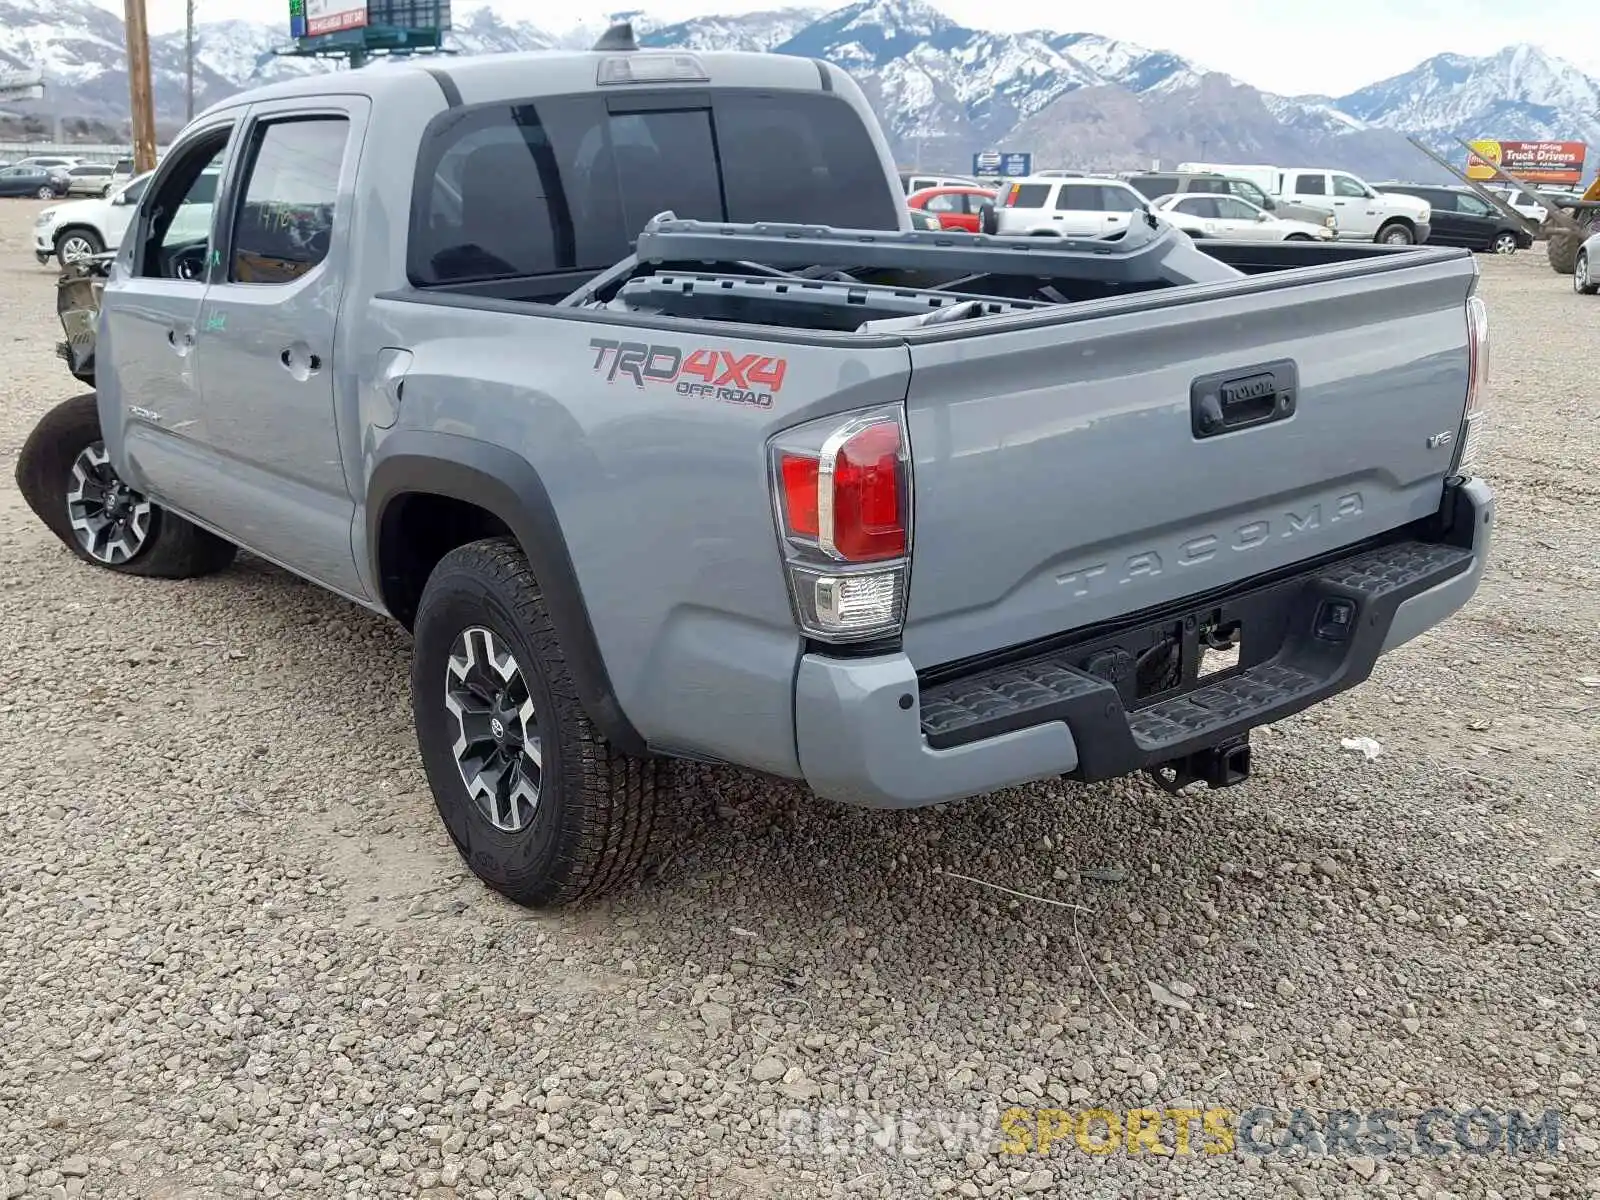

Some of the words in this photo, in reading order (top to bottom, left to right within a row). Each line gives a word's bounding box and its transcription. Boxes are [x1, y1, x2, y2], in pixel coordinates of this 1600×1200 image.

[1506, 150, 1534, 160] Truck
[1537, 150, 1576, 161] Drivers
[589, 337, 684, 390] TRD
[675, 381, 716, 400] OFF
[715, 386, 775, 411] ROAD
[1226, 381, 1274, 402] TOYOTA
[1426, 430, 1452, 449] V6
[1055, 491, 1365, 597] TACOMA
